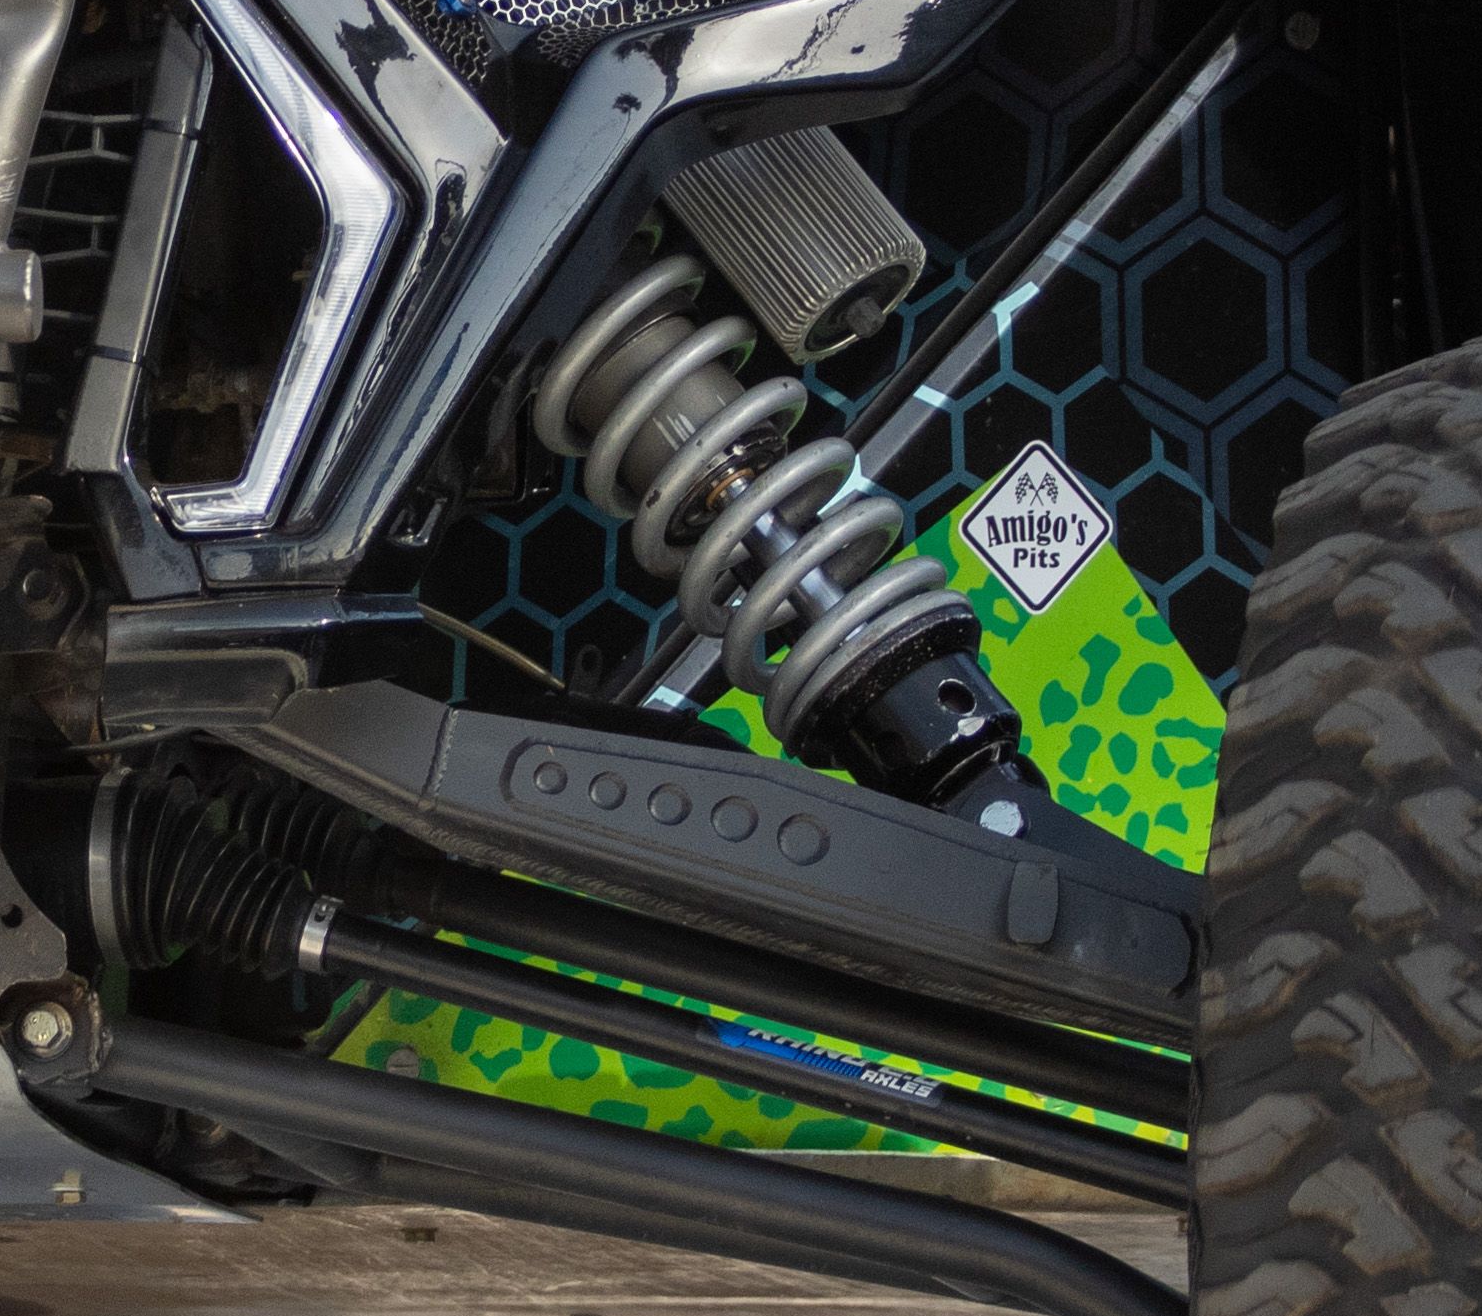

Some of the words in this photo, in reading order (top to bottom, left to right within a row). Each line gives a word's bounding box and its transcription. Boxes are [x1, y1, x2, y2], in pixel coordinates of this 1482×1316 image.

[985, 510, 1088, 548] Amigo's
[1013, 548, 1060, 568] Pits
[859, 1069, 935, 1098] AXLES
